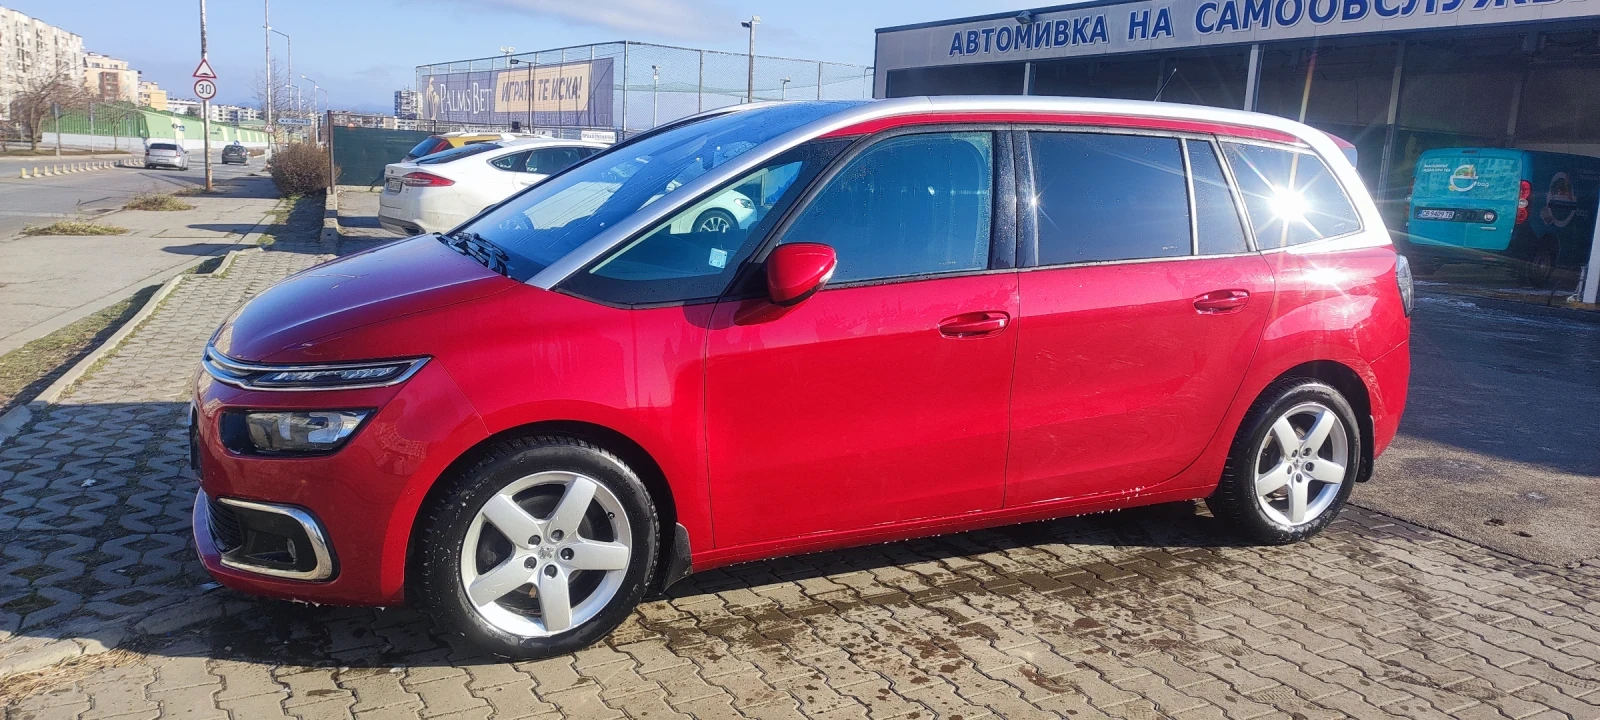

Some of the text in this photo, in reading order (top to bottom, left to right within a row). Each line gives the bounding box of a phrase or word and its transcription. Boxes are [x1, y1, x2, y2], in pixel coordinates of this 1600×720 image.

[949, 14, 1108, 56] АВТОМИВКА
[1128, 6, 1175, 40] НА
[198, 84, 212, 94] 30
[538, 78, 550, 101] ТЕ
[551, 75, 583, 100] ИСКА!
